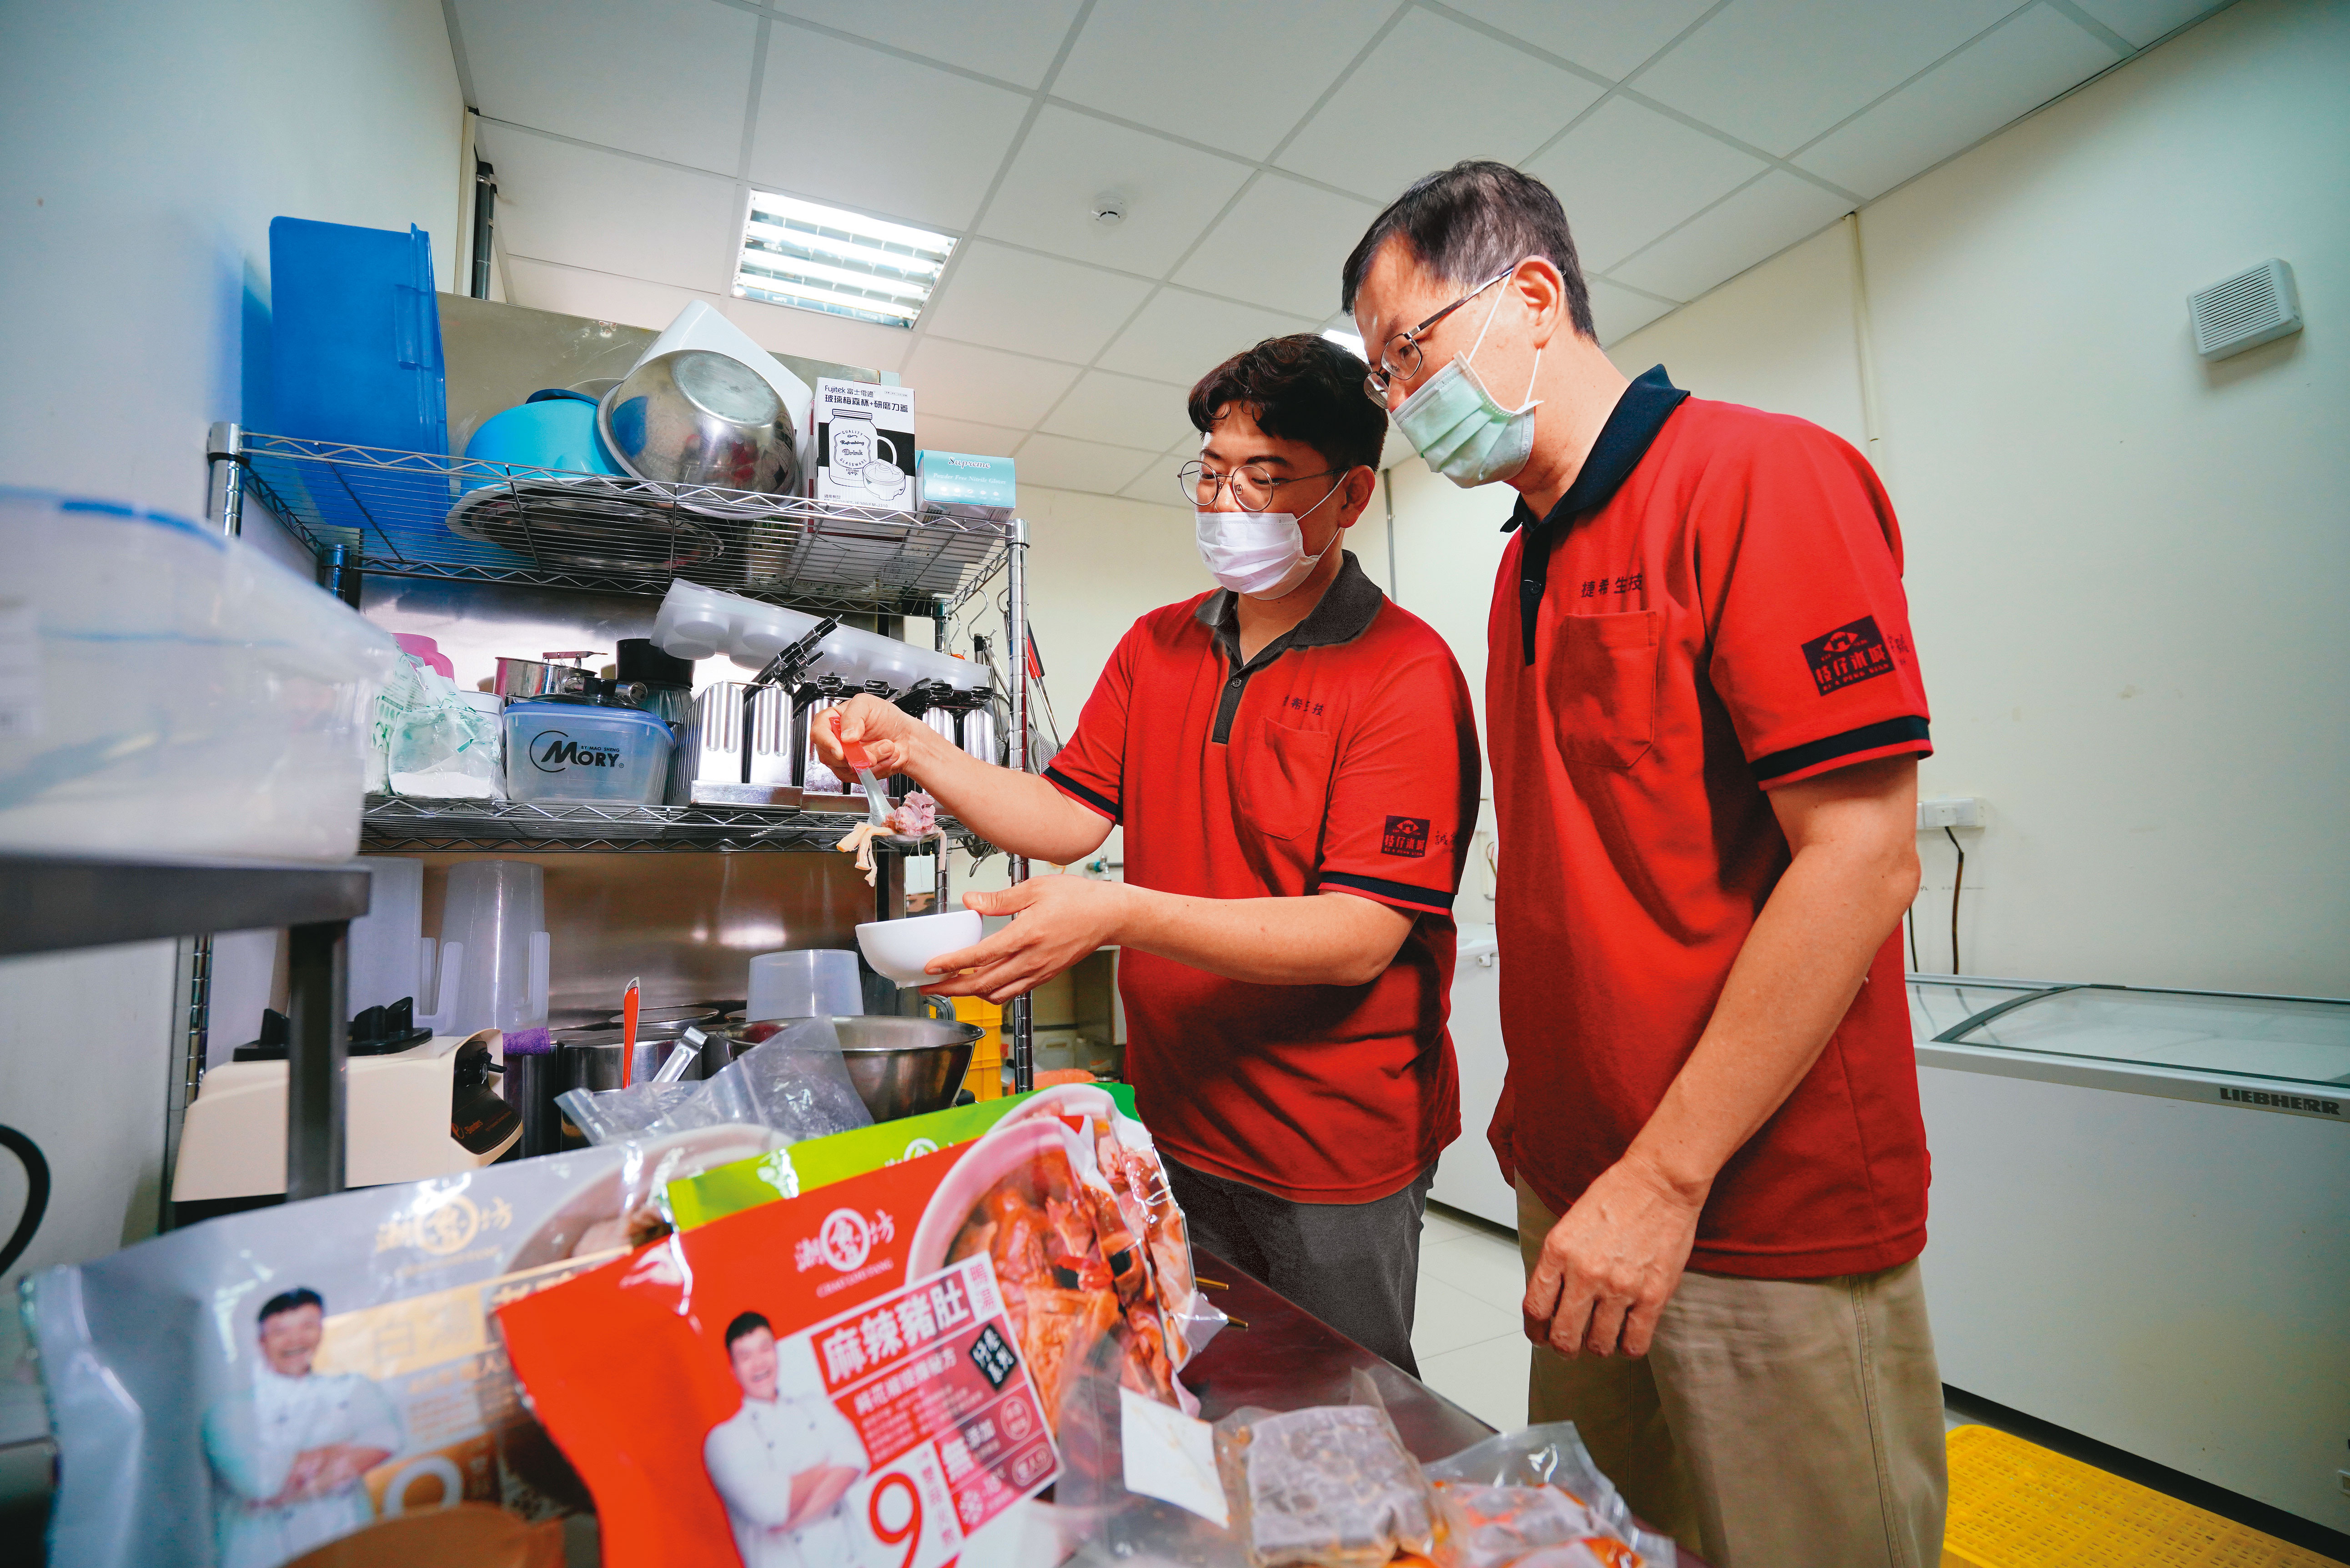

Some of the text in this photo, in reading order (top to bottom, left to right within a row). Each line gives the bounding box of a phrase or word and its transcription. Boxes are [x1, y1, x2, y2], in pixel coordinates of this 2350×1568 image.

[825, 385, 874, 397] Fujitek 富士電通
[825, 394, 908, 412] 玻璃梅森杯+研磨刀蓋
[840, 458, 867, 467] GLASSWARE
[948, 456, 991, 469] Supreme
[2219, 1087, 2341, 1115] LIEBHERR
[821, 1278, 969, 1384] 麻辣豬肚
[869, 1472, 923, 1568] 9
